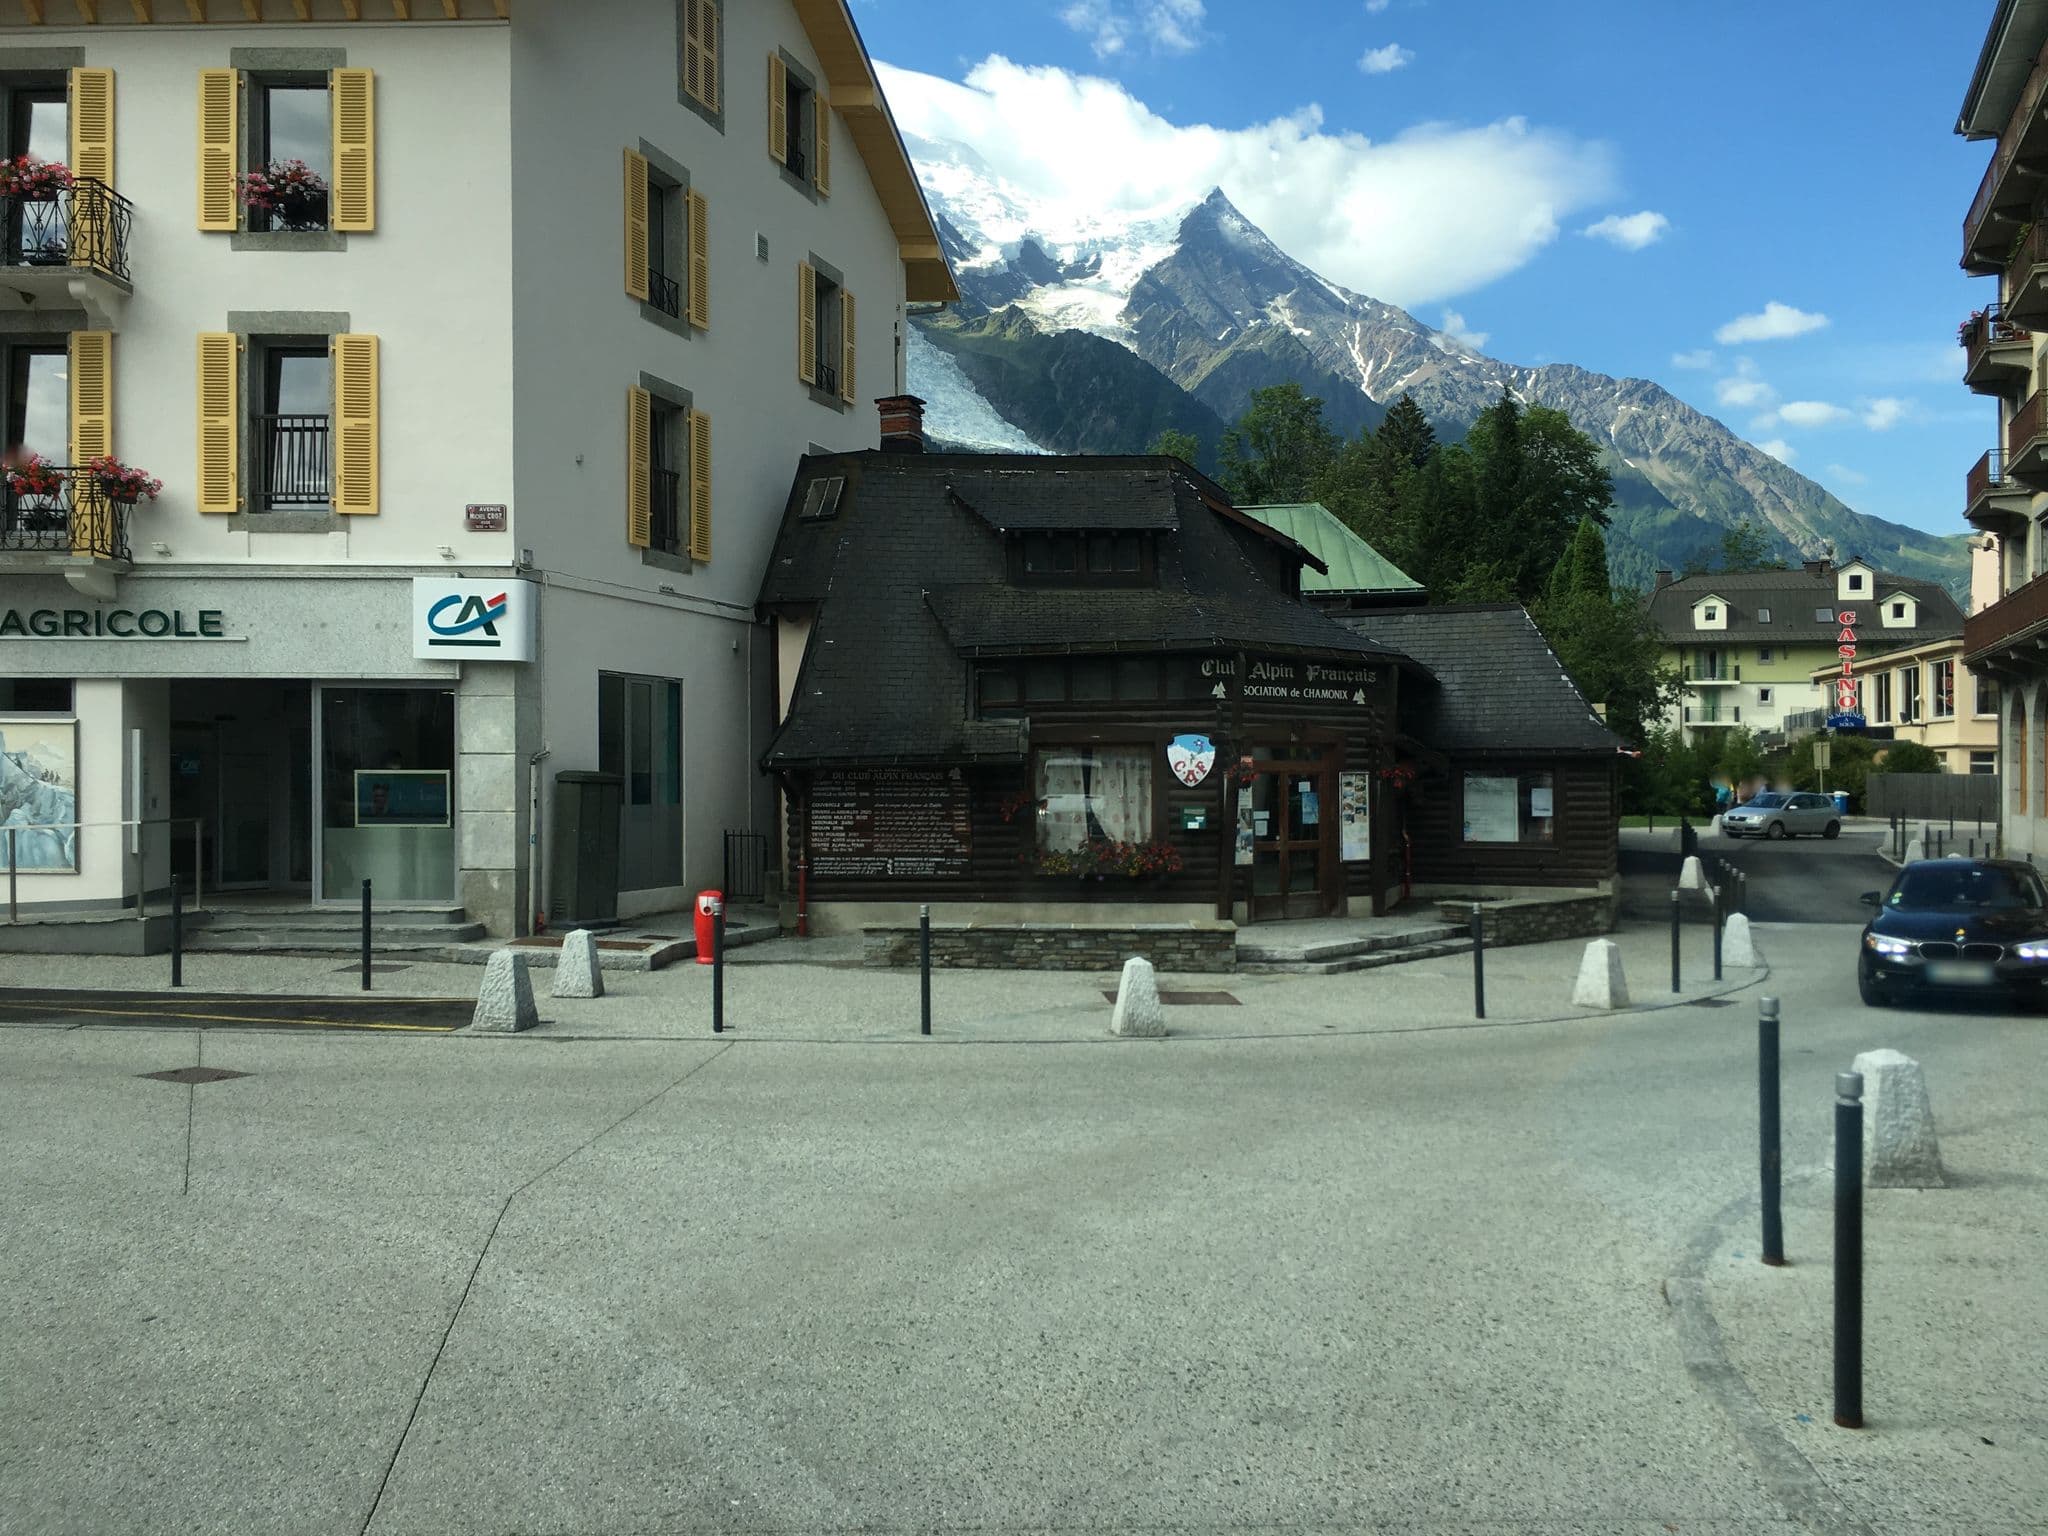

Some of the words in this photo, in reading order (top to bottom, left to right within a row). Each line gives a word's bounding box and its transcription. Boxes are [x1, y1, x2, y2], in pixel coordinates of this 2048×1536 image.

[0, 609, 223, 637] AGRICOLE
[1838, 611, 1857, 708] CASINO
[1249, 663, 1294, 681] Alpin
[1306, 664, 1377, 684] Français
[1290, 686, 1300, 698] de
[1303, 687, 1348, 700] CHAMONIX
[873, 772, 899, 781] ALPIN
